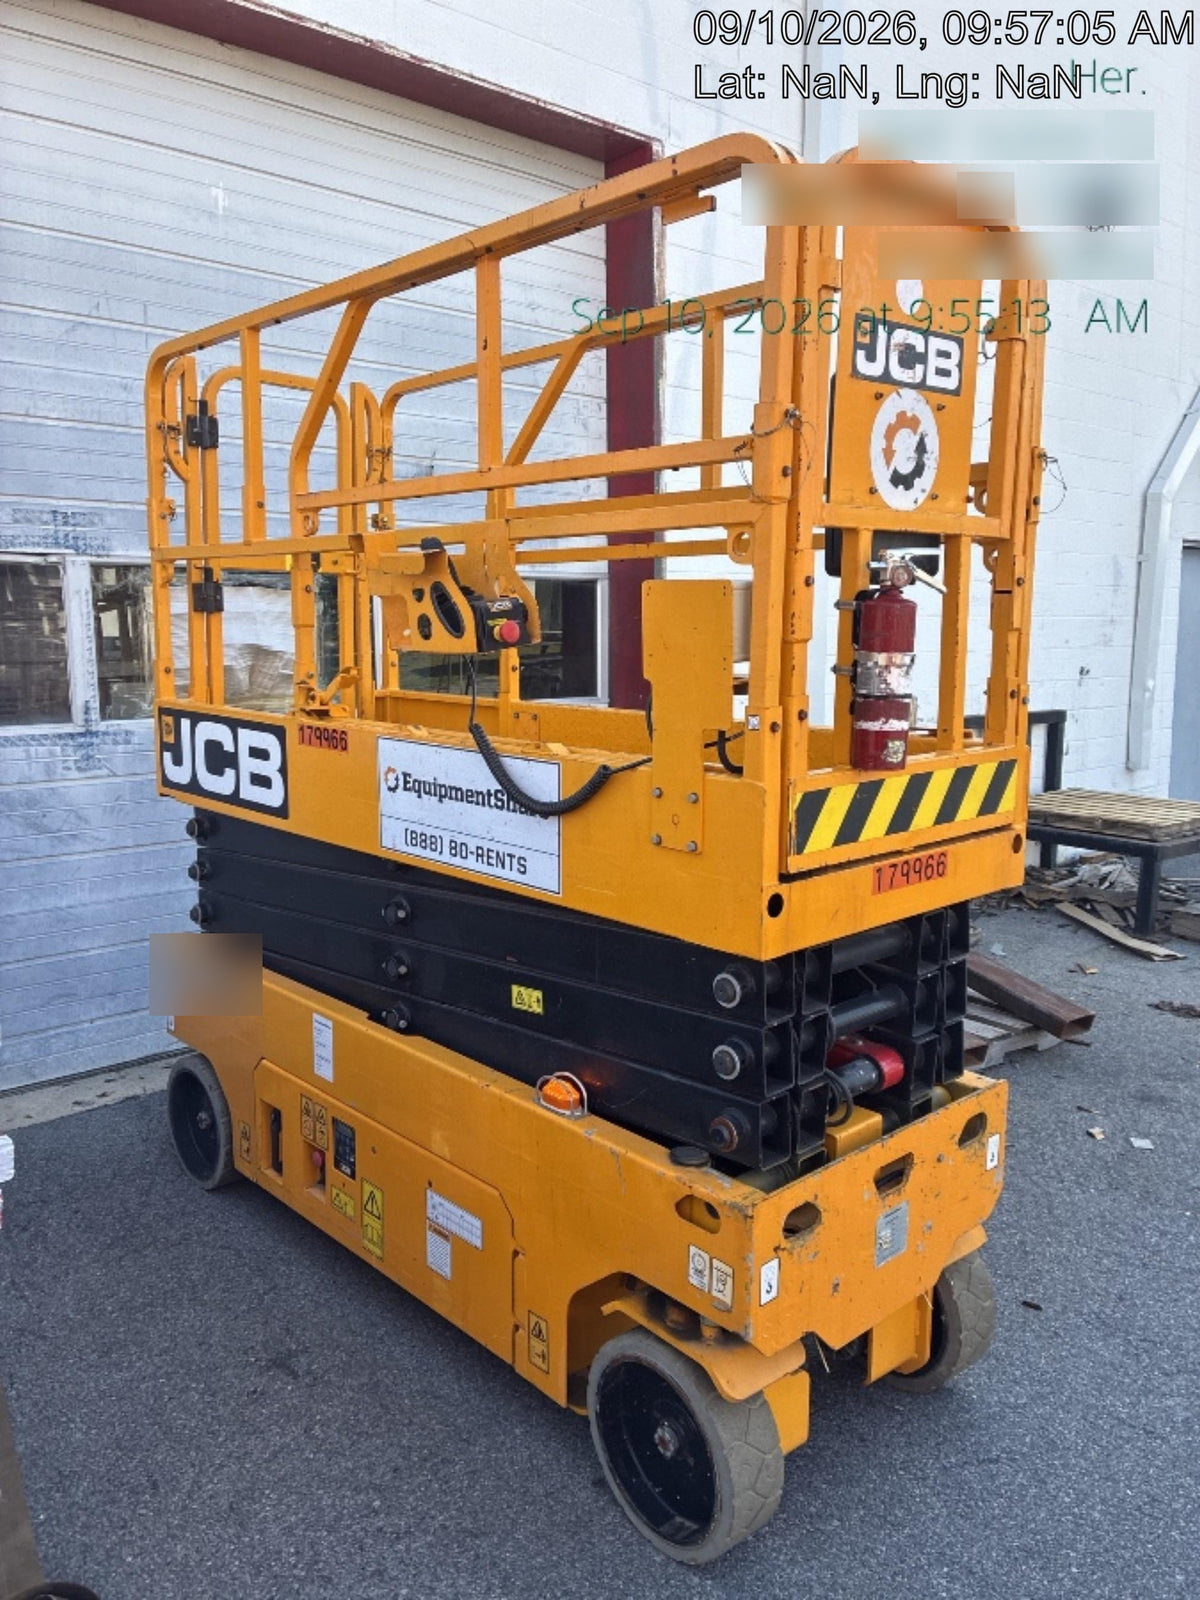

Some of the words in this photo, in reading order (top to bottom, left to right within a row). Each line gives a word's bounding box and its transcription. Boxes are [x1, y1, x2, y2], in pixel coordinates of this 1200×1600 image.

[856, 323, 961, 390] JCB
[162, 717, 285, 808] JCB
[298, 724, 348, 752] 179966
[401, 771, 550, 820] EquipmentSh
[404, 827, 444, 856] (888)
[449, 838, 528, 876] 80-RENTS
[875, 852, 947, 894] 179966
